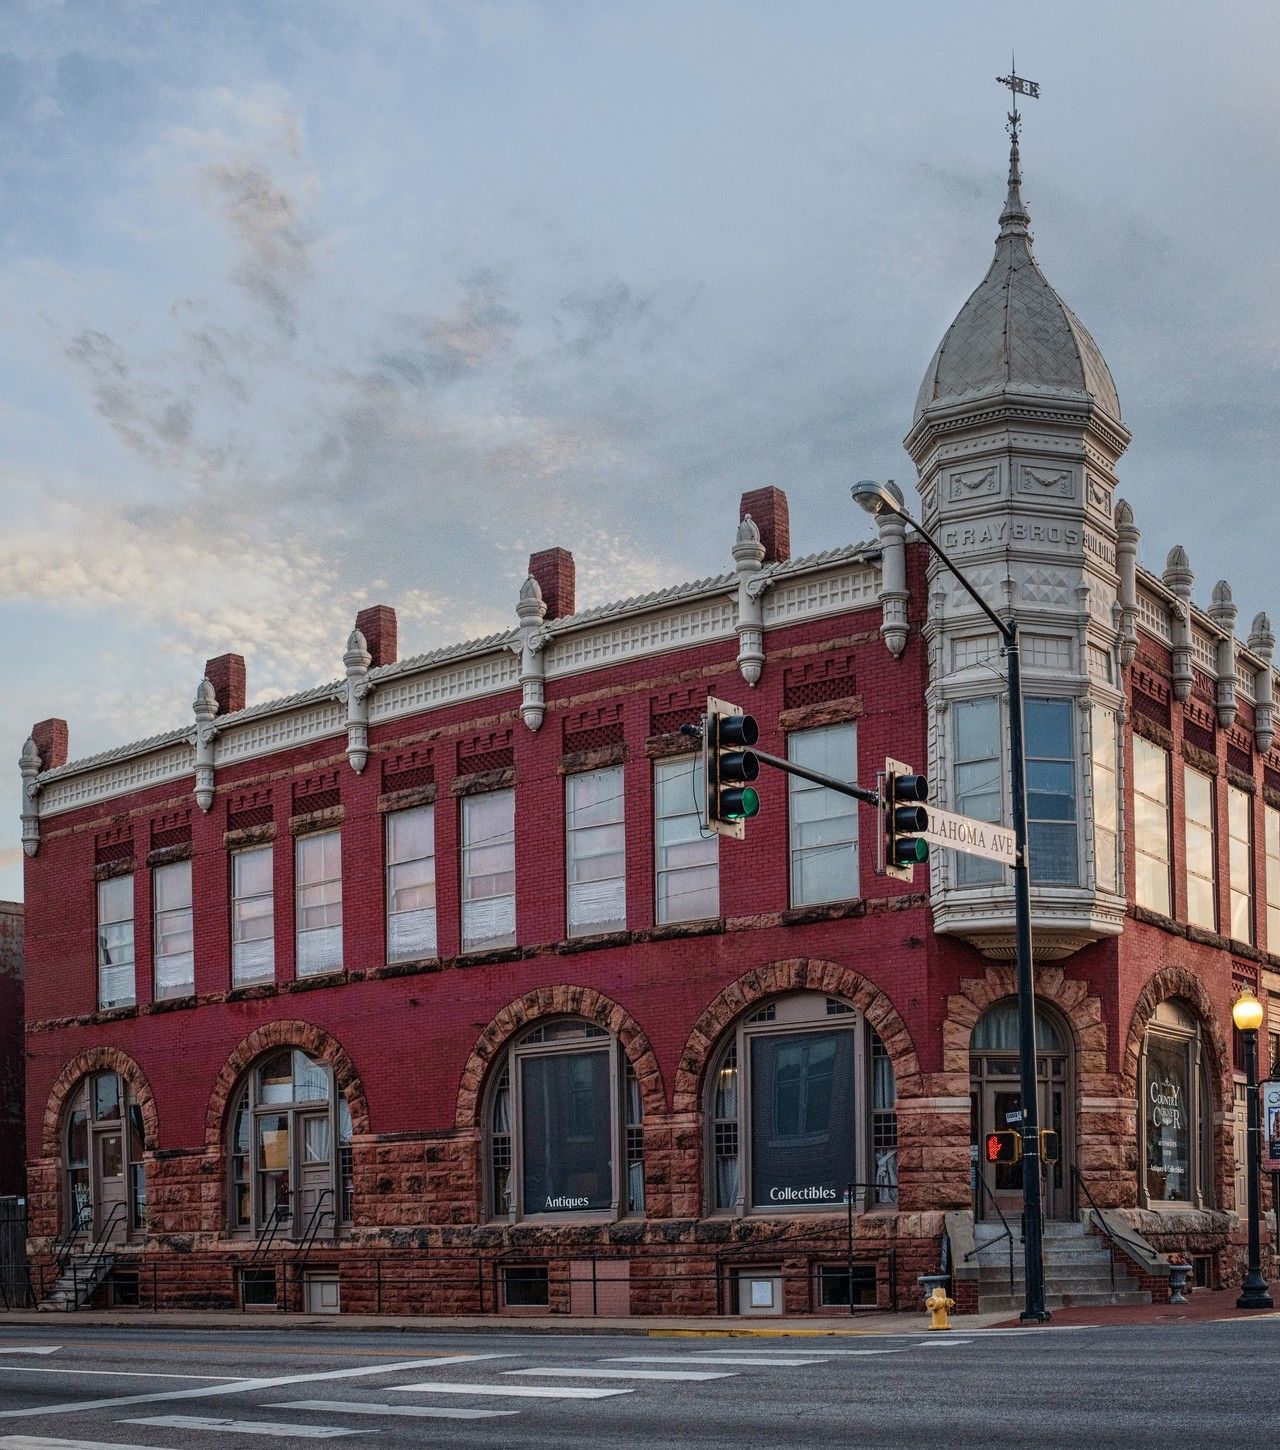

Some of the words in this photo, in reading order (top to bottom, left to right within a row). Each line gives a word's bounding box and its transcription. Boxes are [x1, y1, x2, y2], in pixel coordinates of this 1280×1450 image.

[944, 522, 1007, 548] GRAY
[1012, 524, 1079, 545] BROS
[1084, 529, 1116, 568] BUILDING
[927, 814, 986, 848] LAHOMA
[991, 834, 1014, 856] AVE
[545, 1195, 589, 1208] Antiques
[770, 1186, 836, 1200] Collectibles
